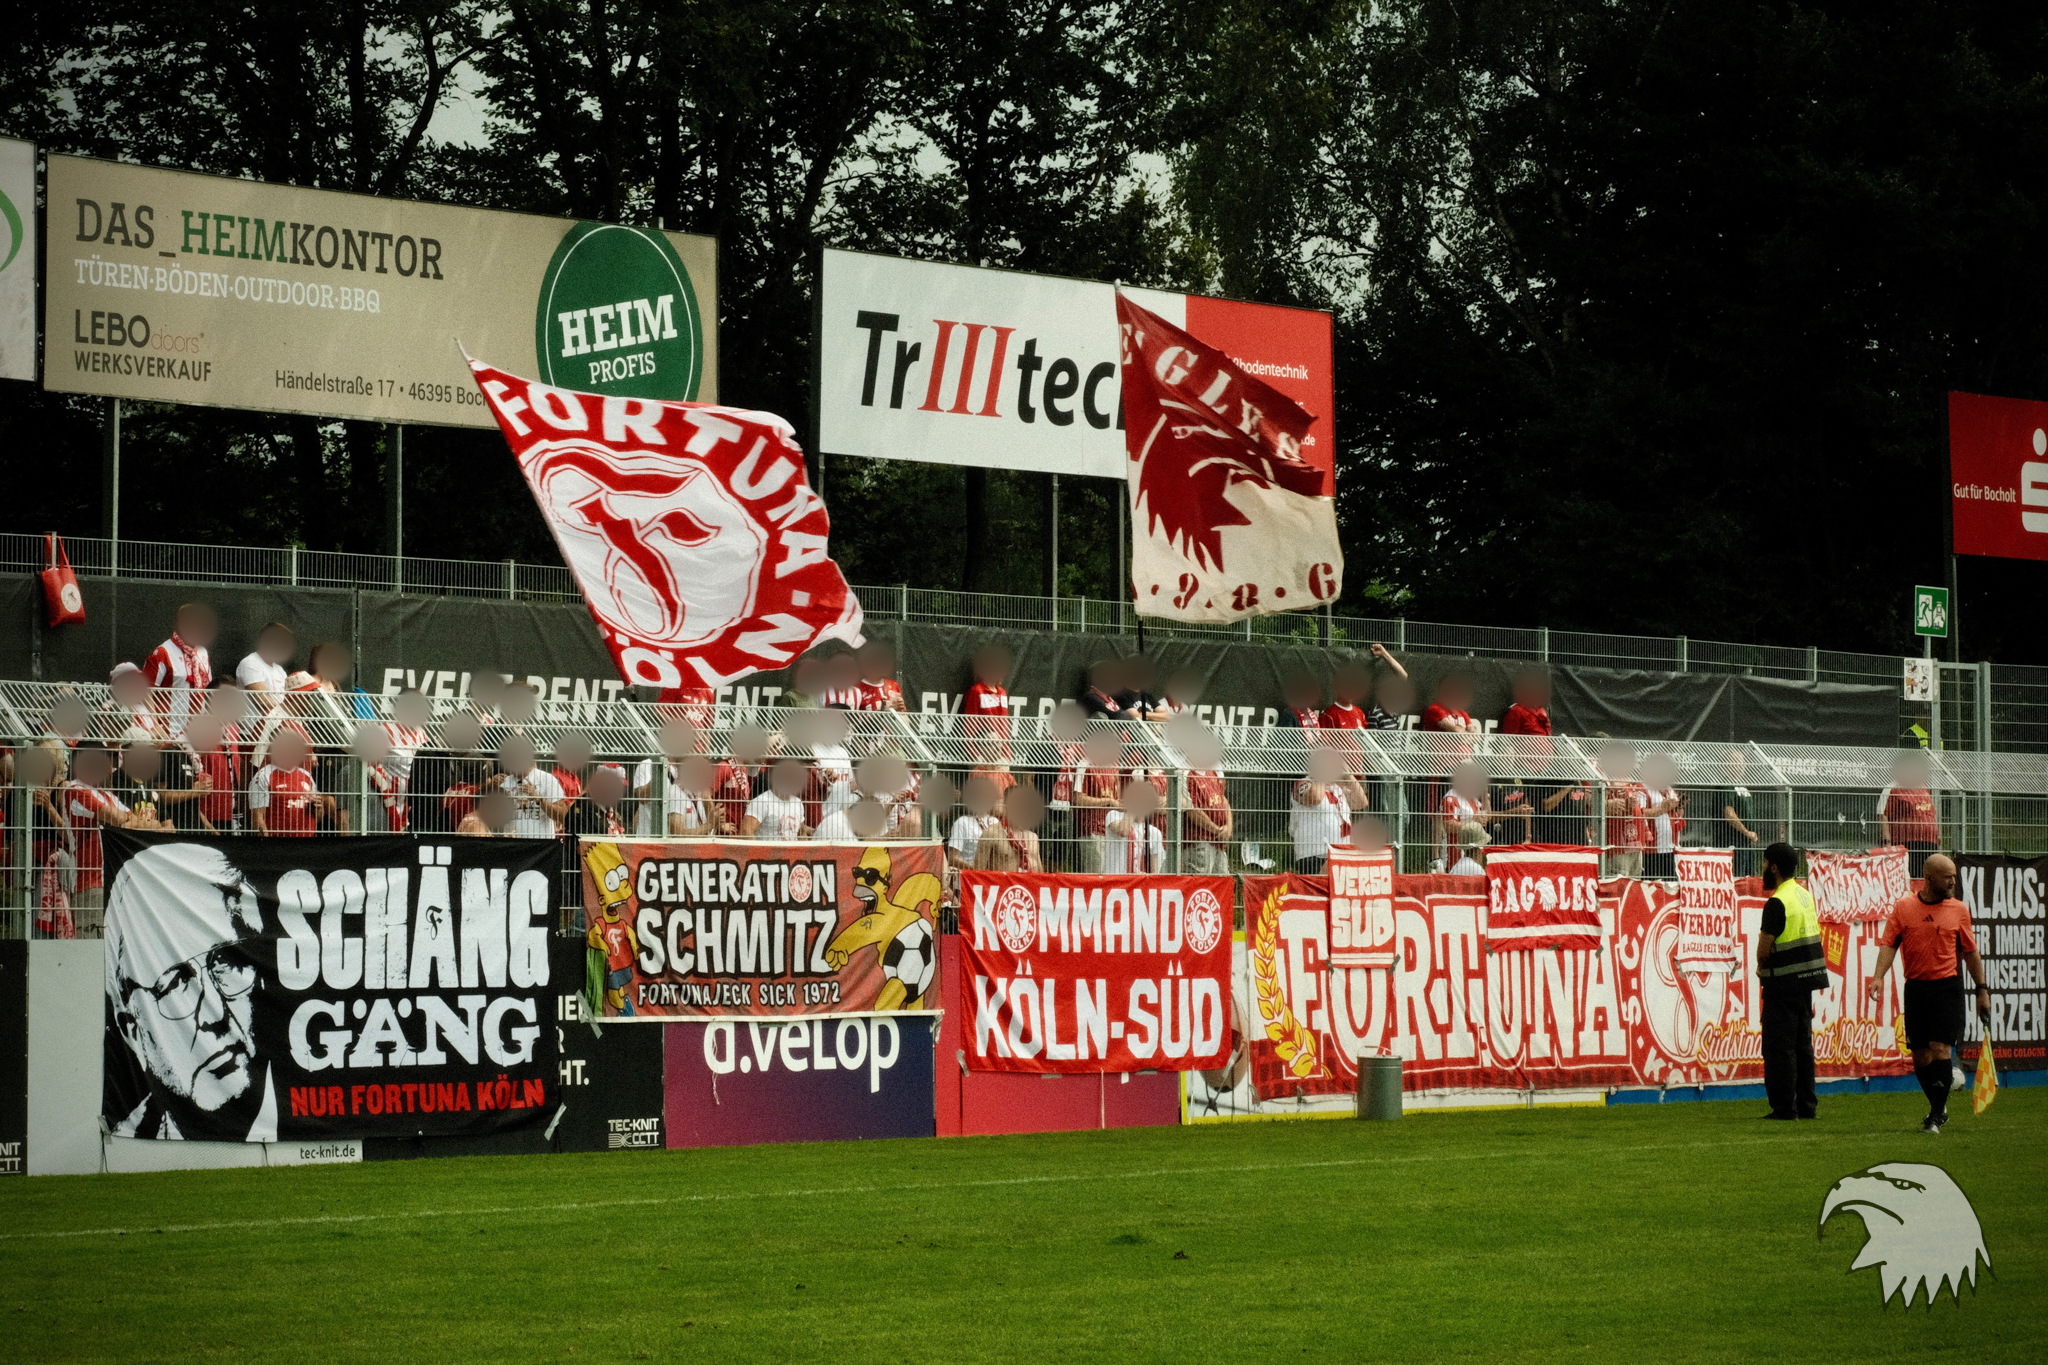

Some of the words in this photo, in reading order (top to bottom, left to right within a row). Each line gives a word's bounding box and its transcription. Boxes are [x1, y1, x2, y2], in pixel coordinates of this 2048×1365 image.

[557, 294, 678, 358] HEIM
[74, 350, 212, 382] WERKSVERKAUF
[588, 352, 657, 385] PROFIS
[275, 369, 373, 396] Händelstraße
[378, 378, 395, 397] 17
[408, 382, 452, 403] 46395
[480, 377, 829, 580] FORTUNA
[1953, 482, 1968, 498] Gut
[1970, 484, 1983, 500] für
[1984, 486, 2016, 503] Bocholt
[612, 611, 816, 689] ÖLN
[1331, 865, 1392, 896] VERSO
[1677, 859, 1733, 885] SEKTION
[1679, 886, 1734, 911] STADION
[1960, 866, 2046, 920] KLAUS:
[276, 845, 550, 990] SCHÄNG
[1330, 898, 1396, 949] SUD
[1680, 912, 1732, 938] VERBOT
[637, 907, 838, 976] SCHMITZ
[1995, 924, 2045, 956] IMMER
[637, 982, 751, 1006] FORTUNAJECK
[759, 982, 796, 1006] SICK
[803, 981, 841, 1004] 1972
[974, 959, 1224, 1061] KÖLN-SÜD
[288, 994, 541, 1073] GÄNG
[1812, 1025, 1837, 1062] eit
[1837, 1020, 1876, 1063] 1948
[2013, 1046, 2047, 1059] COLOGNE
[289, 1085, 346, 1117] NUR
[351, 1081, 472, 1115] FORTUNA
[476, 1073, 546, 1112] KÖLN
[299, 1144, 357, 1161] tec-knit.de
